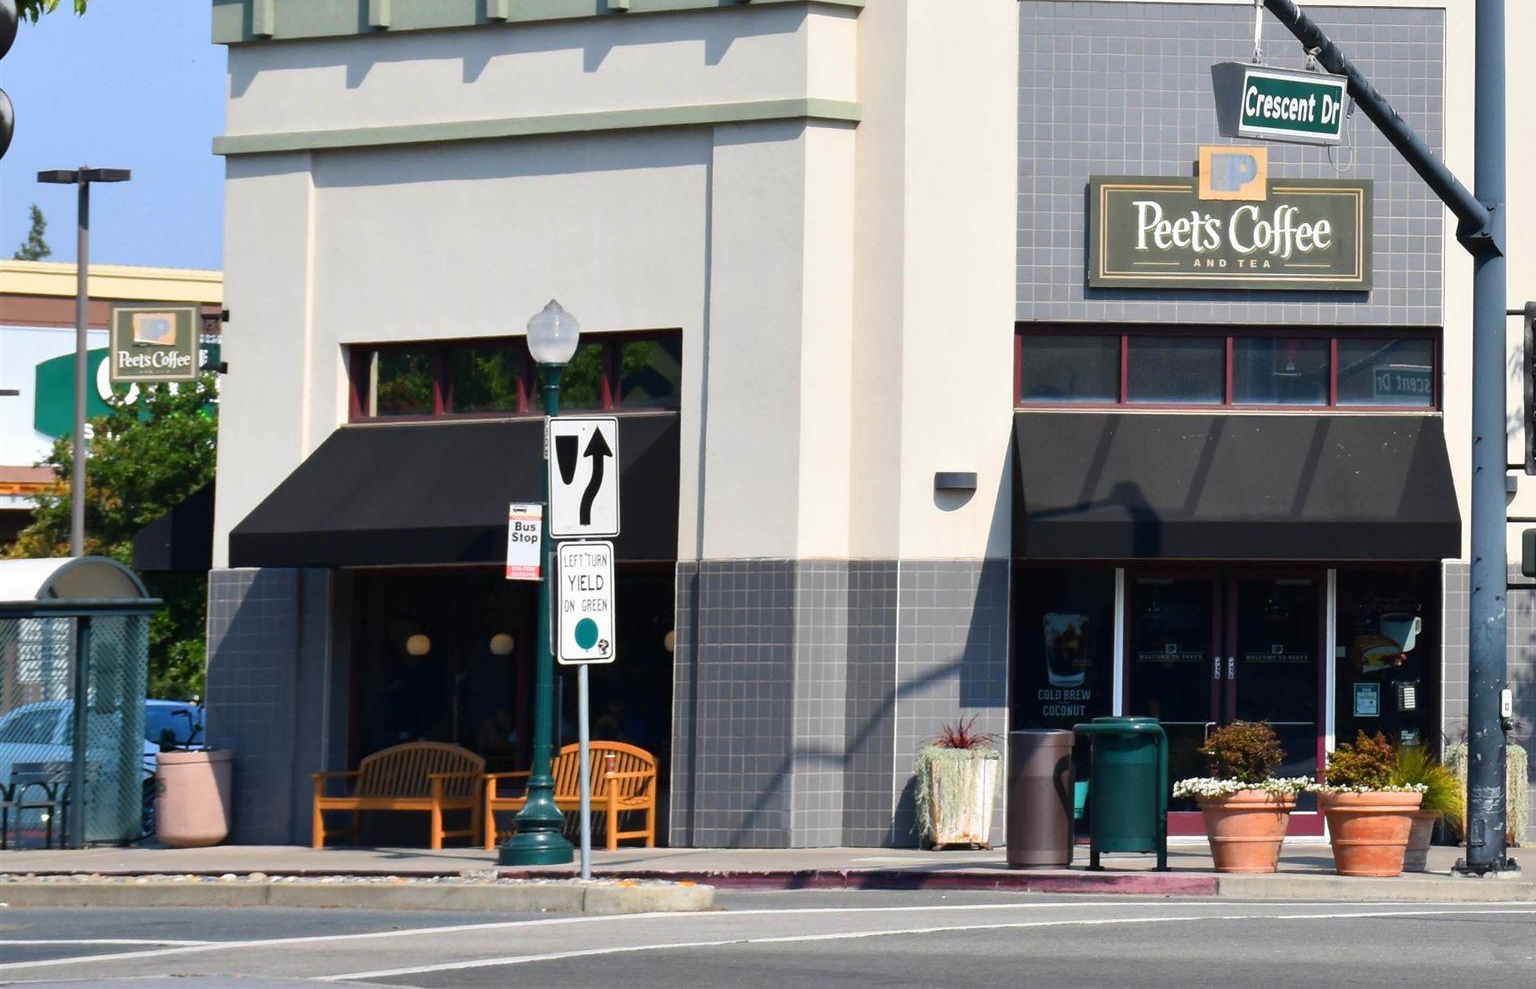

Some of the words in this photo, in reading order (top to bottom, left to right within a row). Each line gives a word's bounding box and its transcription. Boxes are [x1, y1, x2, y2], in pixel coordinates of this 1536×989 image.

[1245, 85, 1316, 123] Crescent
[1320, 94, 1340, 125] Dr
[1132, 200, 1222, 253] Peet's
[1227, 204, 1332, 260] Coffee
[1193, 258, 1227, 268] AND
[1237, 259, 1271, 269] TEA
[118, 350, 151, 369] Peet's
[152, 350, 192, 369] Coffee
[514, 521, 537, 533] Bus
[511, 532, 539, 545] Stop
[564, 553, 584, 568] LEFT
[587, 553, 608, 568] TURN
[568, 575, 604, 592] YIELD
[564, 599, 575, 612] ON
[581, 599, 608, 612] GREEN
[1038, 689, 1062, 701] COLD
[1063, 689, 1092, 701] BREW
[1042, 705, 1086, 717] COCONUT
